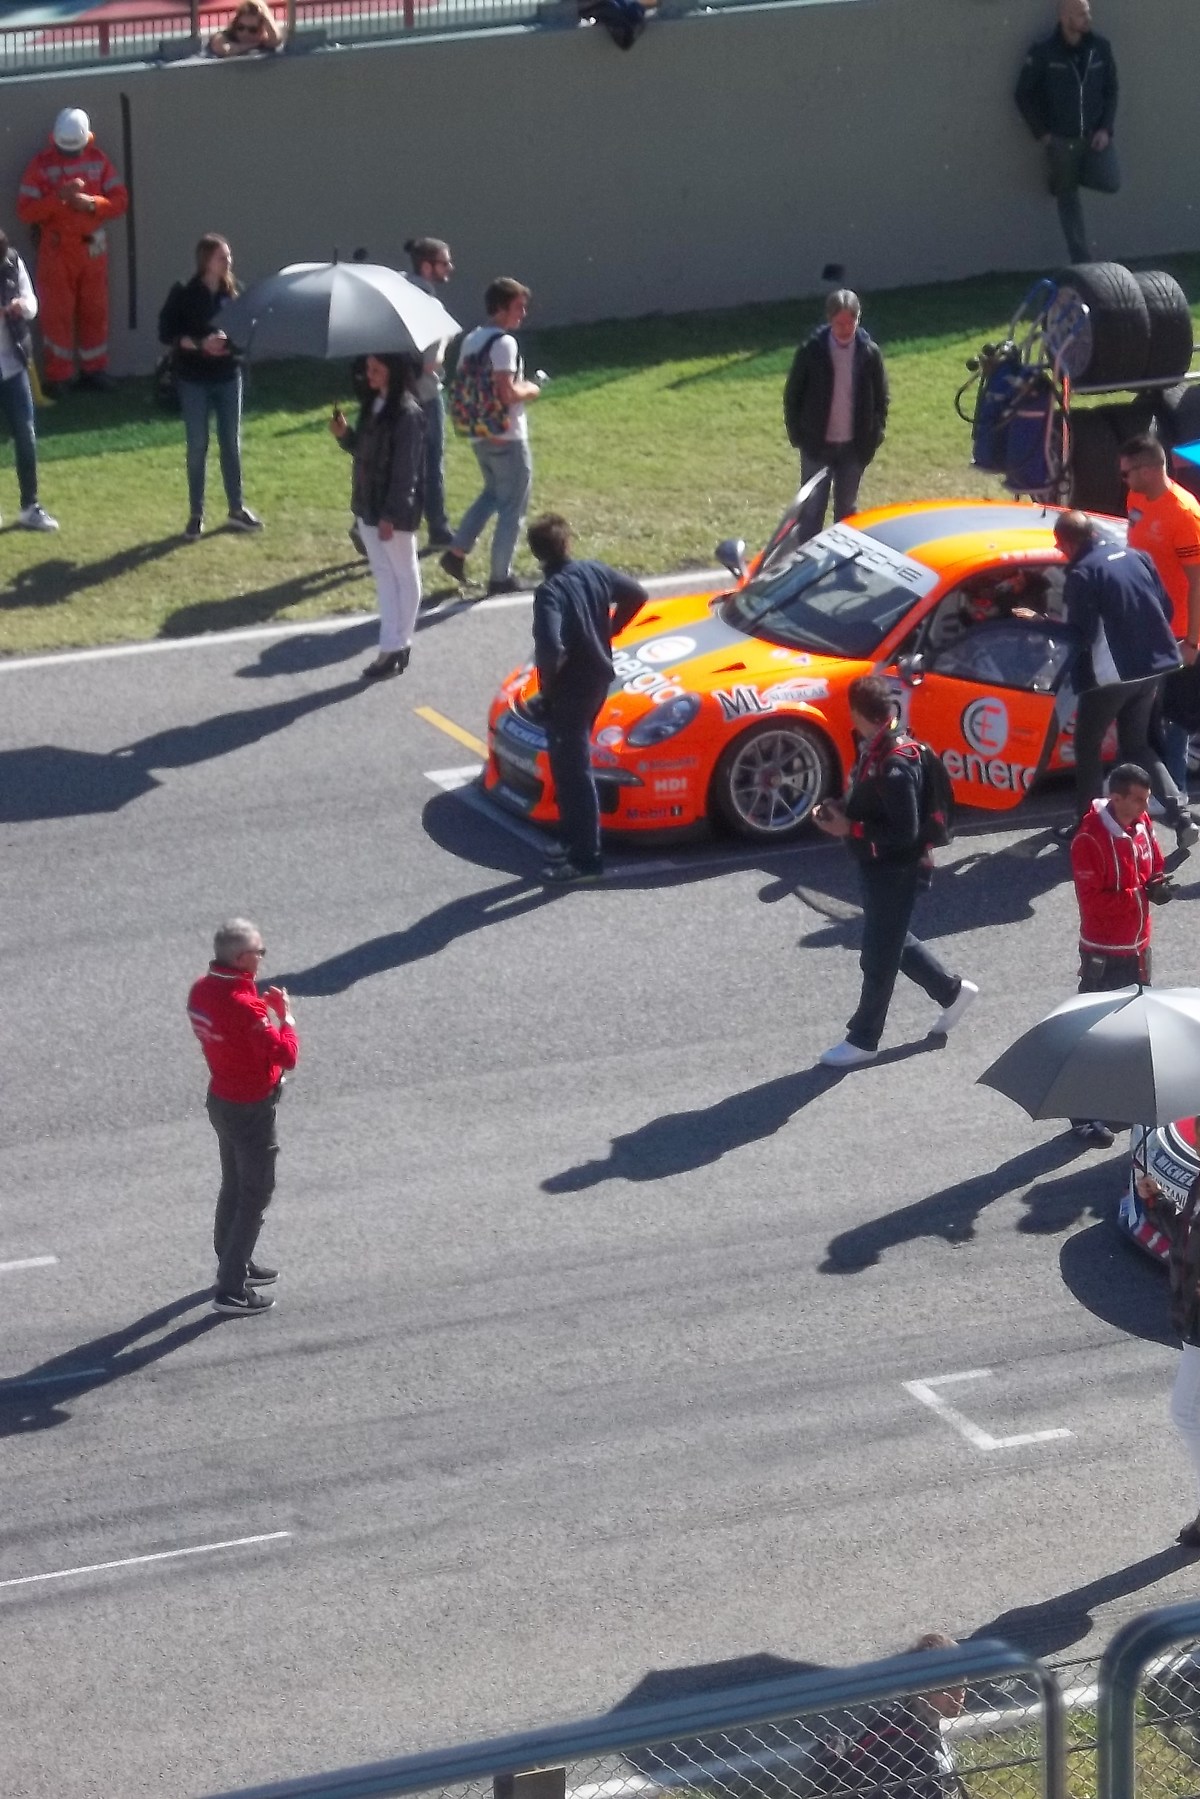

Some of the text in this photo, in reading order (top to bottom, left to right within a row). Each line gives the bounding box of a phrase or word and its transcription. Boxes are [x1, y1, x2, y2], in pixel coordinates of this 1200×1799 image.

[612, 651, 686, 704] nergia
[717, 687, 773, 718] ML
[655, 777, 687, 792] HDI
[1155, 1155, 1196, 1187] MICHEL
